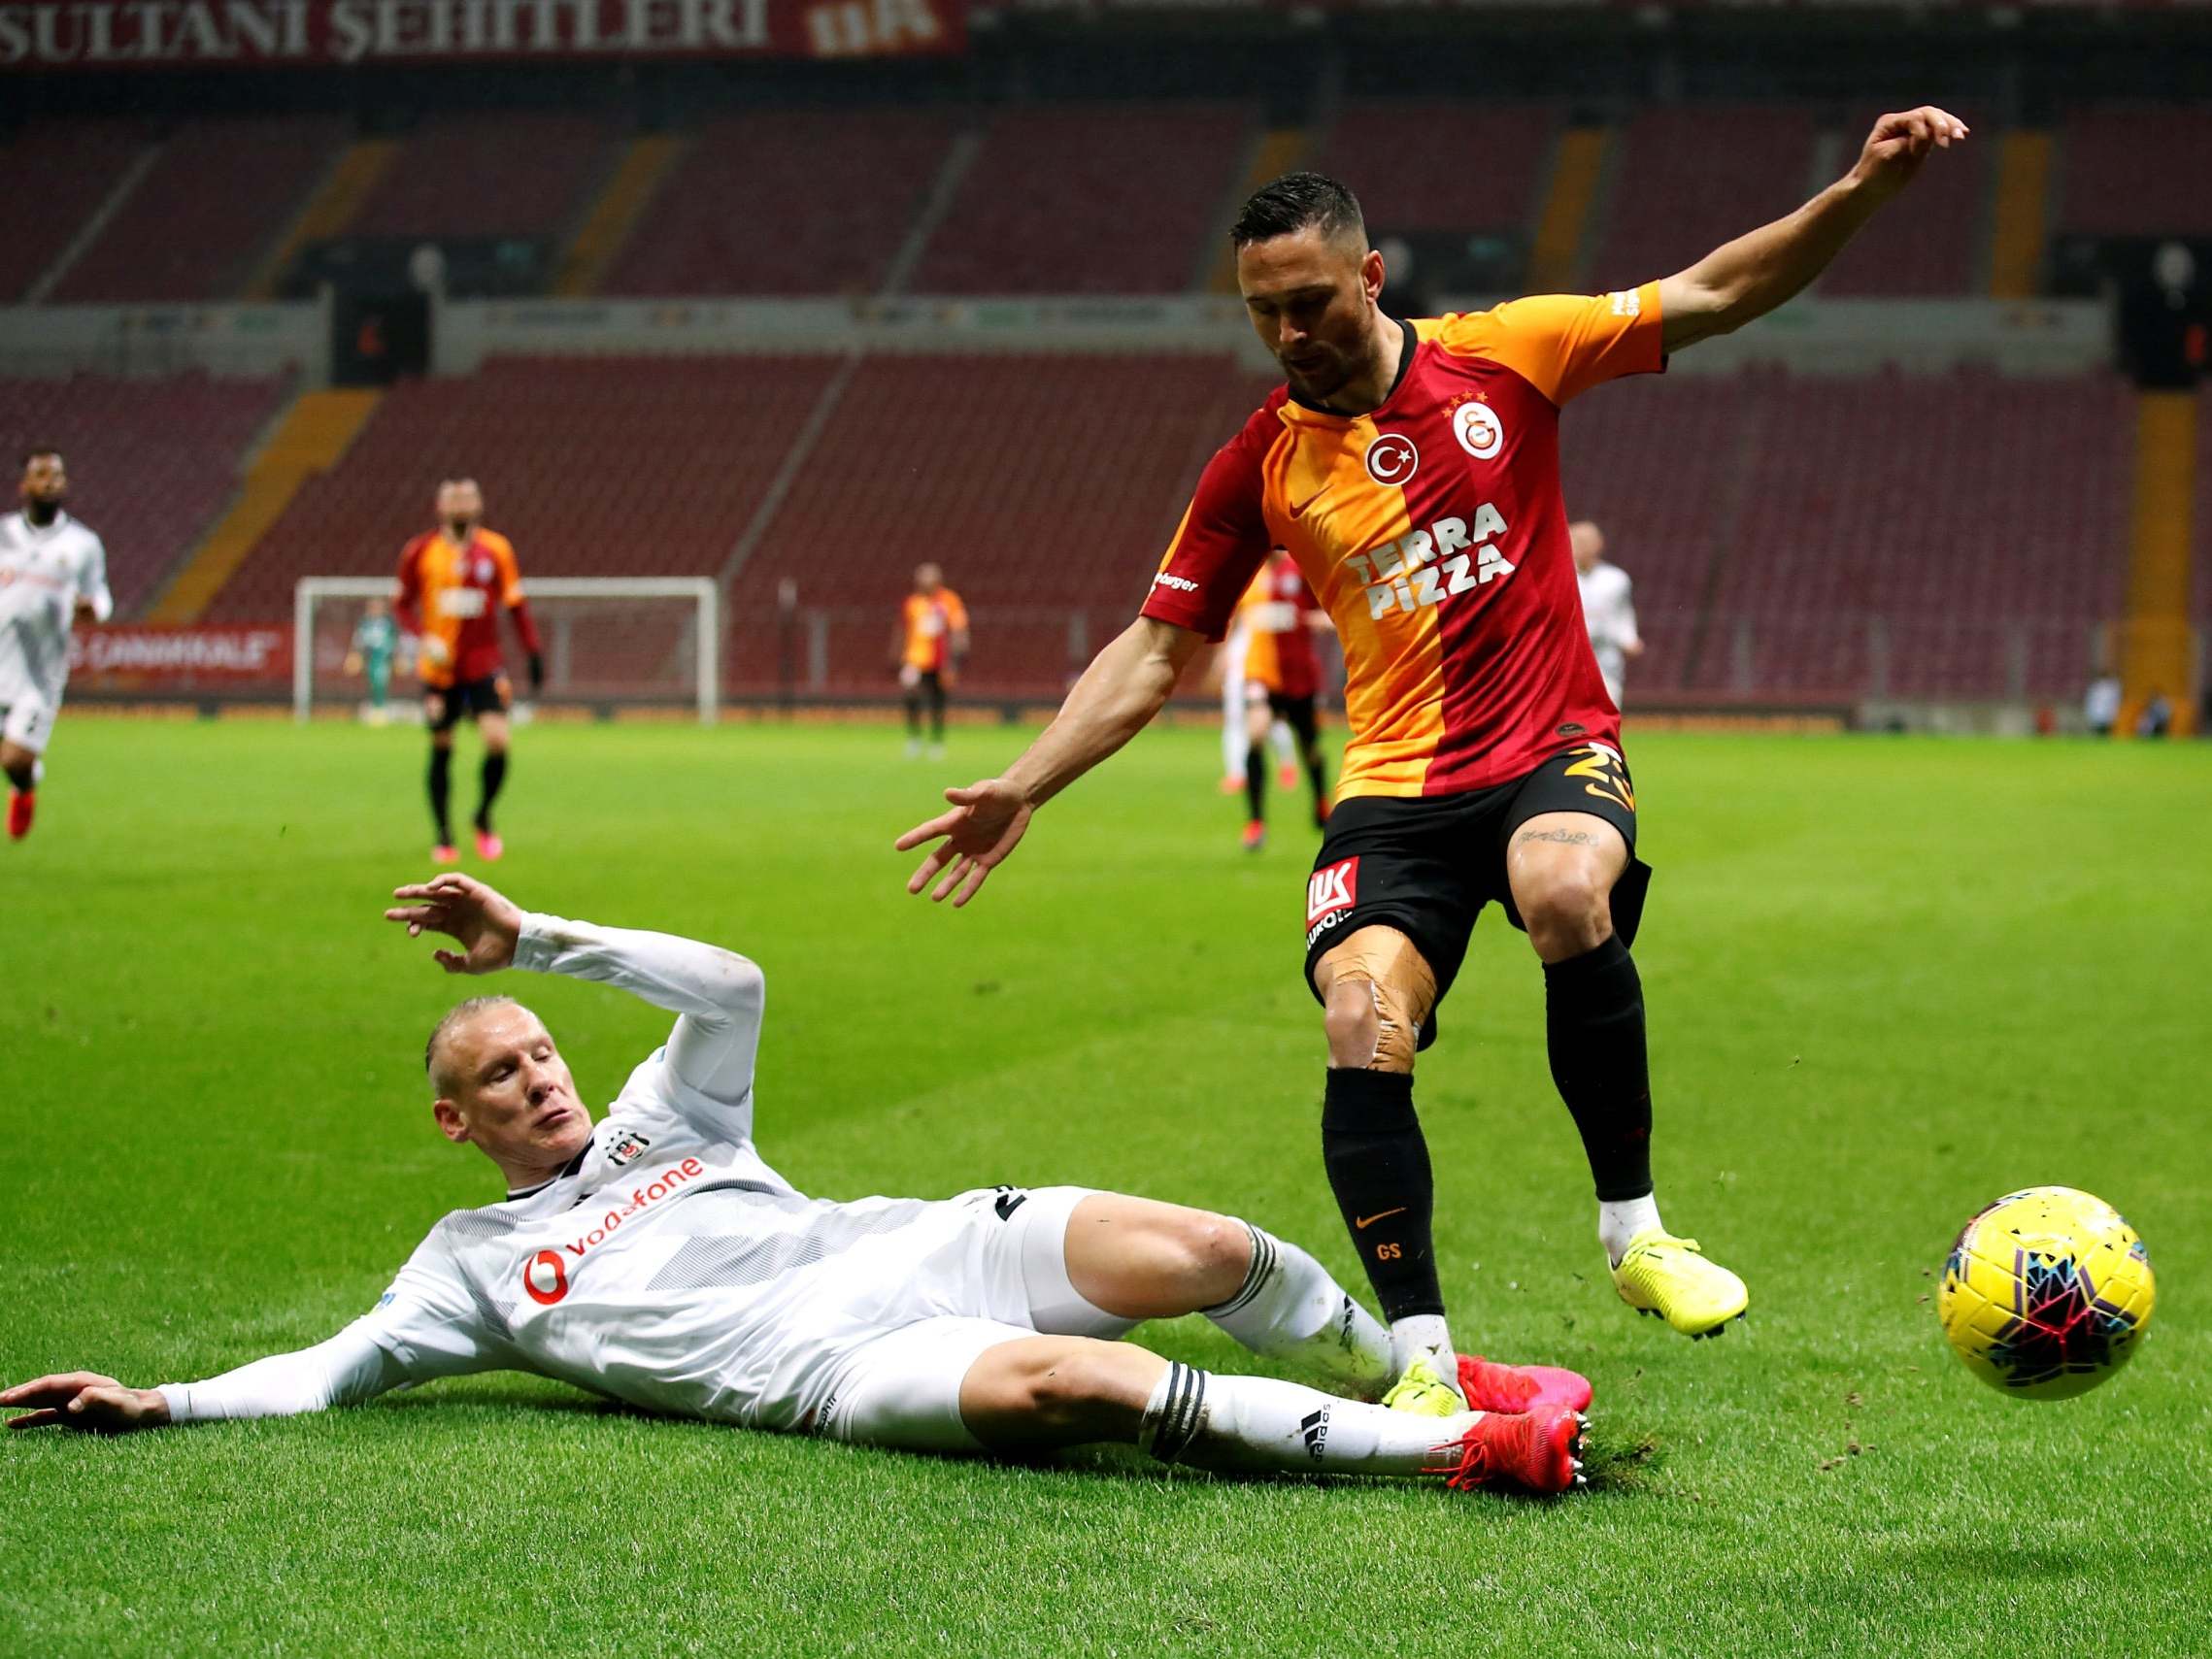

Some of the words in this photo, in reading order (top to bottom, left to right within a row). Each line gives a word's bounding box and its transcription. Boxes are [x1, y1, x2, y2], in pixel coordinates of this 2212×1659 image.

[1344, 502, 1508, 584] TERRA
[565, 1157, 704, 1257] vodafone
[1377, 1243, 1402, 1260] GS
[1315, 1404, 1331, 1462] adidas
